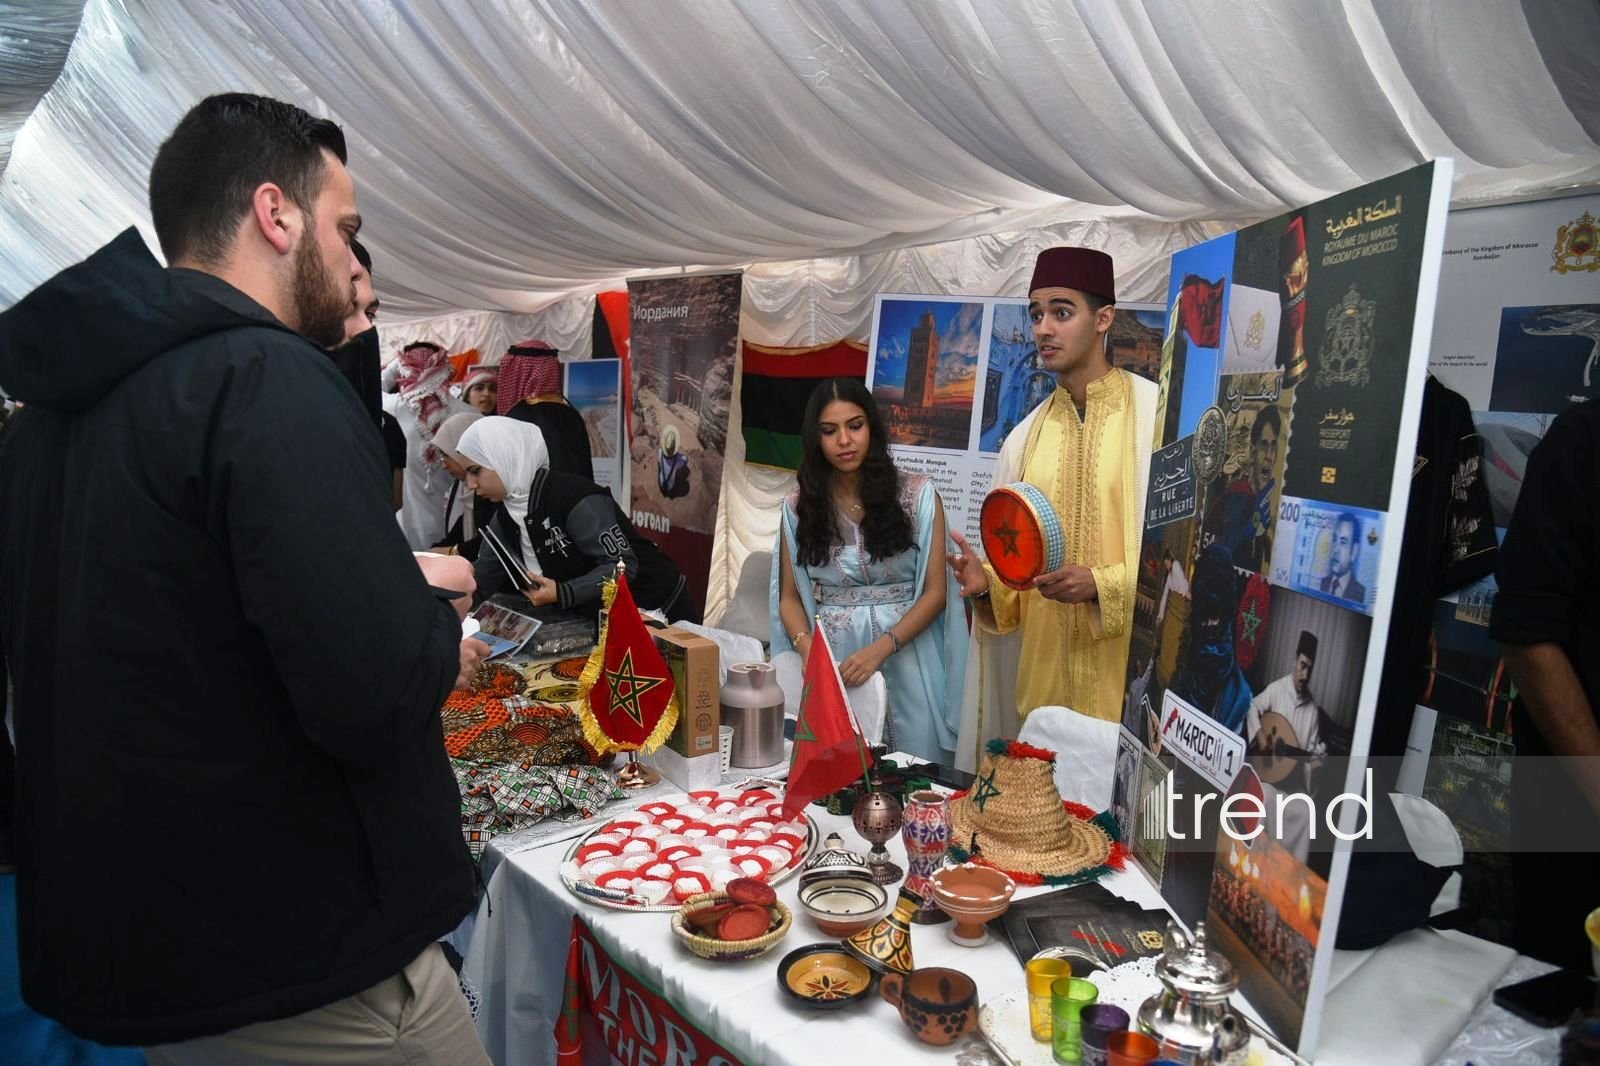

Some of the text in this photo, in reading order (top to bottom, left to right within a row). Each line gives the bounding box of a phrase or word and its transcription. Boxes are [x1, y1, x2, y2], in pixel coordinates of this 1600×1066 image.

[1357, 231, 1369, 245] DU
[1370, 223, 1398, 239] MAROC
[1322, 249, 1352, 267] KINGDOM
[1361, 238, 1398, 257] MOROCCO
[1481, 244, 1504, 253] Kingdom
[1512, 242, 1538, 250] Morocco
[633, 303, 689, 324] Иордания
[896, 456, 947, 467] Koutoubia Mosque
[948, 468, 957, 476] the
[1162, 488, 1176, 502] RUE
[1150, 508, 1157, 521] DE
[1159, 506, 1166, 519] LA
[1280, 502, 1300, 523] 200
[599, 524, 630, 558] 05
